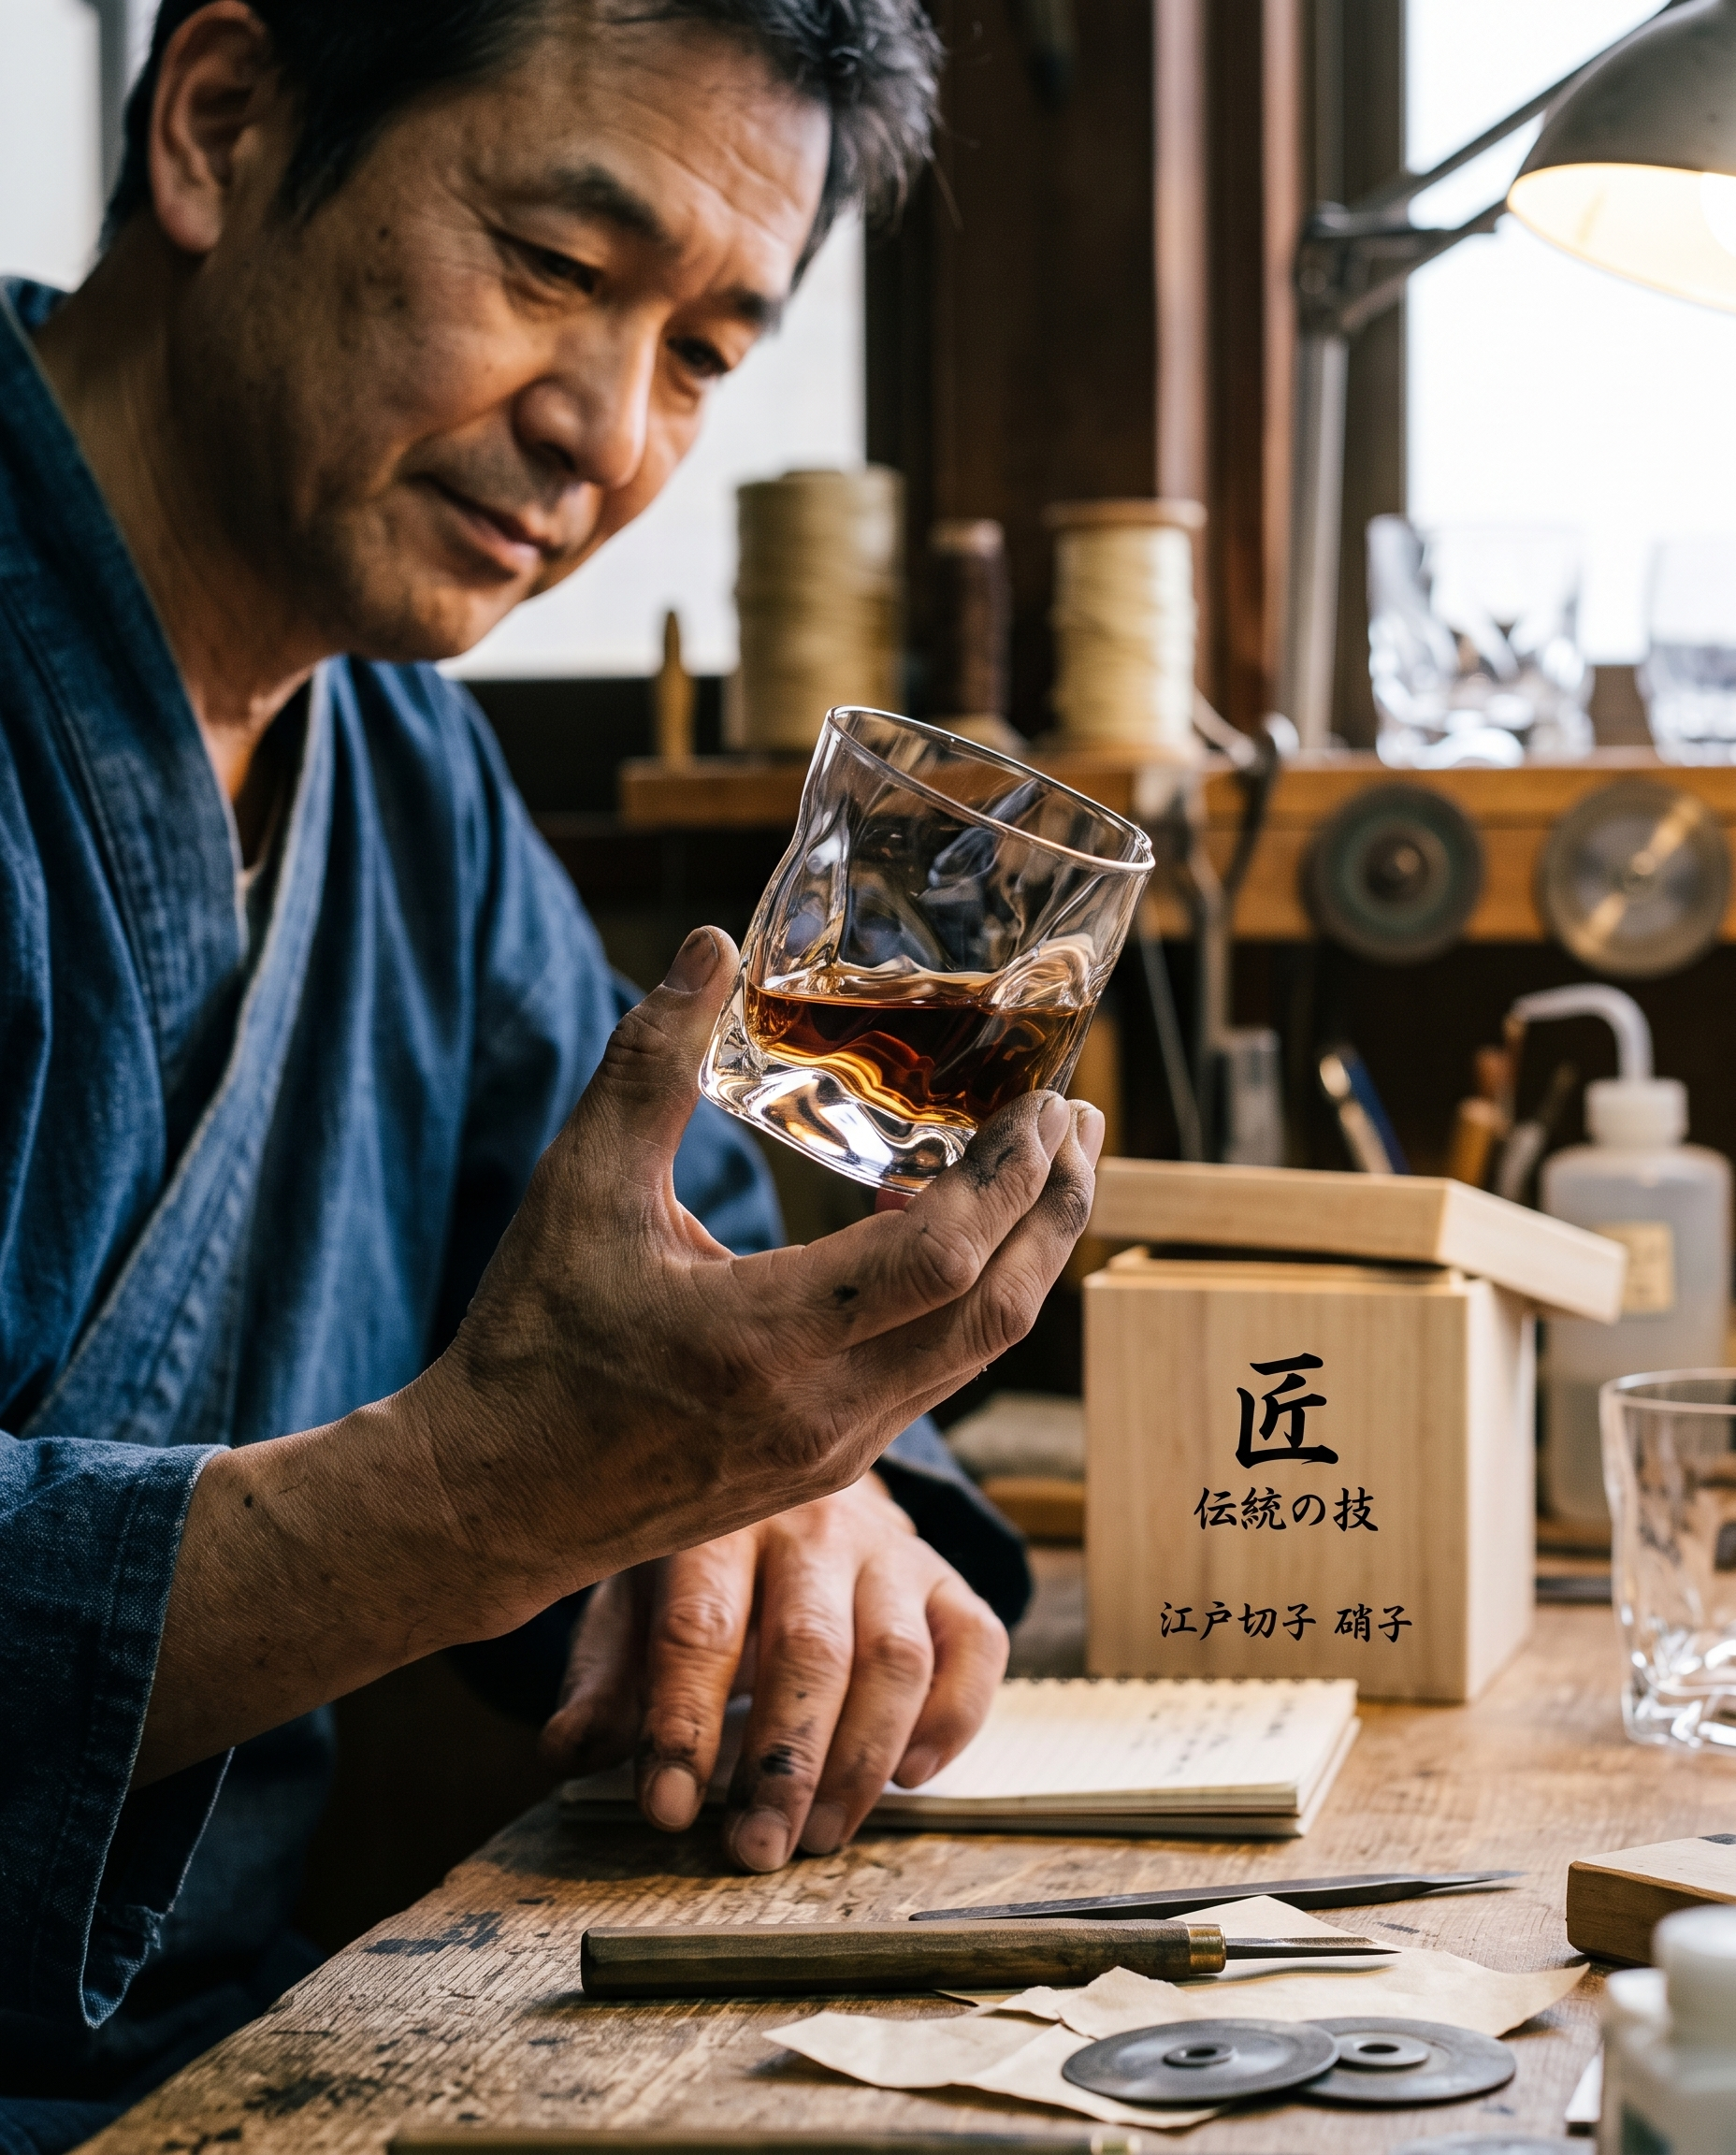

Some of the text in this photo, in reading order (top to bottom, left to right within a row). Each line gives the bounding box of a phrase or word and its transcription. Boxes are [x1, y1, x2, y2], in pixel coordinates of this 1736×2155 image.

[1235, 1352, 1339, 1469] 匠
[1193, 1486, 1379, 1532] 伝統の技
[1334, 1602, 1413, 1643] 硝子
